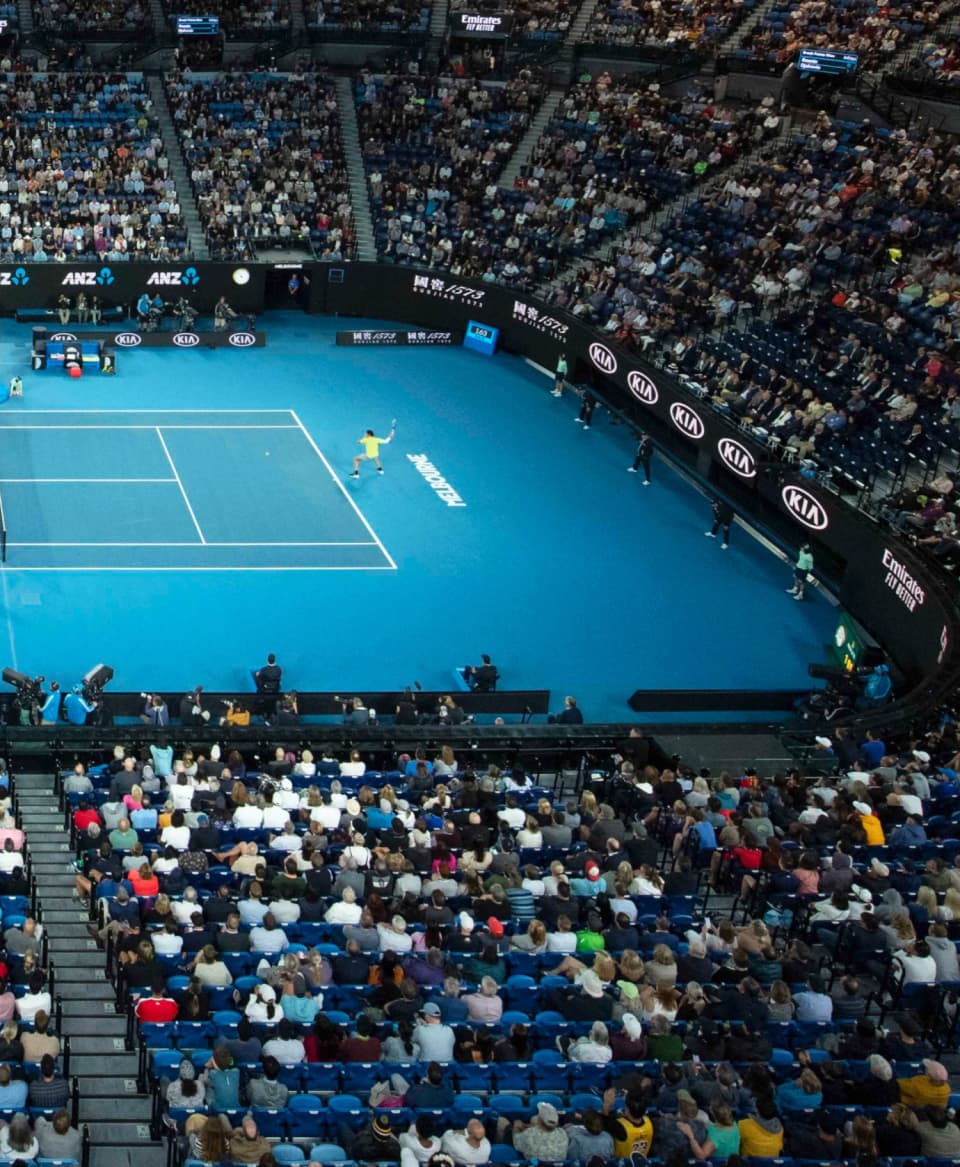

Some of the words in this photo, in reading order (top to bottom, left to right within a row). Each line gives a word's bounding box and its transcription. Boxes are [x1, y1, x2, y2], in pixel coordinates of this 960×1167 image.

[461, 14, 502, 25] Emirates
[62, 272, 96, 285] ANZ
[146, 272, 182, 285] ANZ
[446, 285, 485, 299] 1573
[538, 316, 569, 334] 1573
[406, 453, 467, 506] MELBOURNE
[882, 548, 925, 605] Emirates
[884, 572, 897, 590] FLY
[896, 584, 917, 612] BETTER
